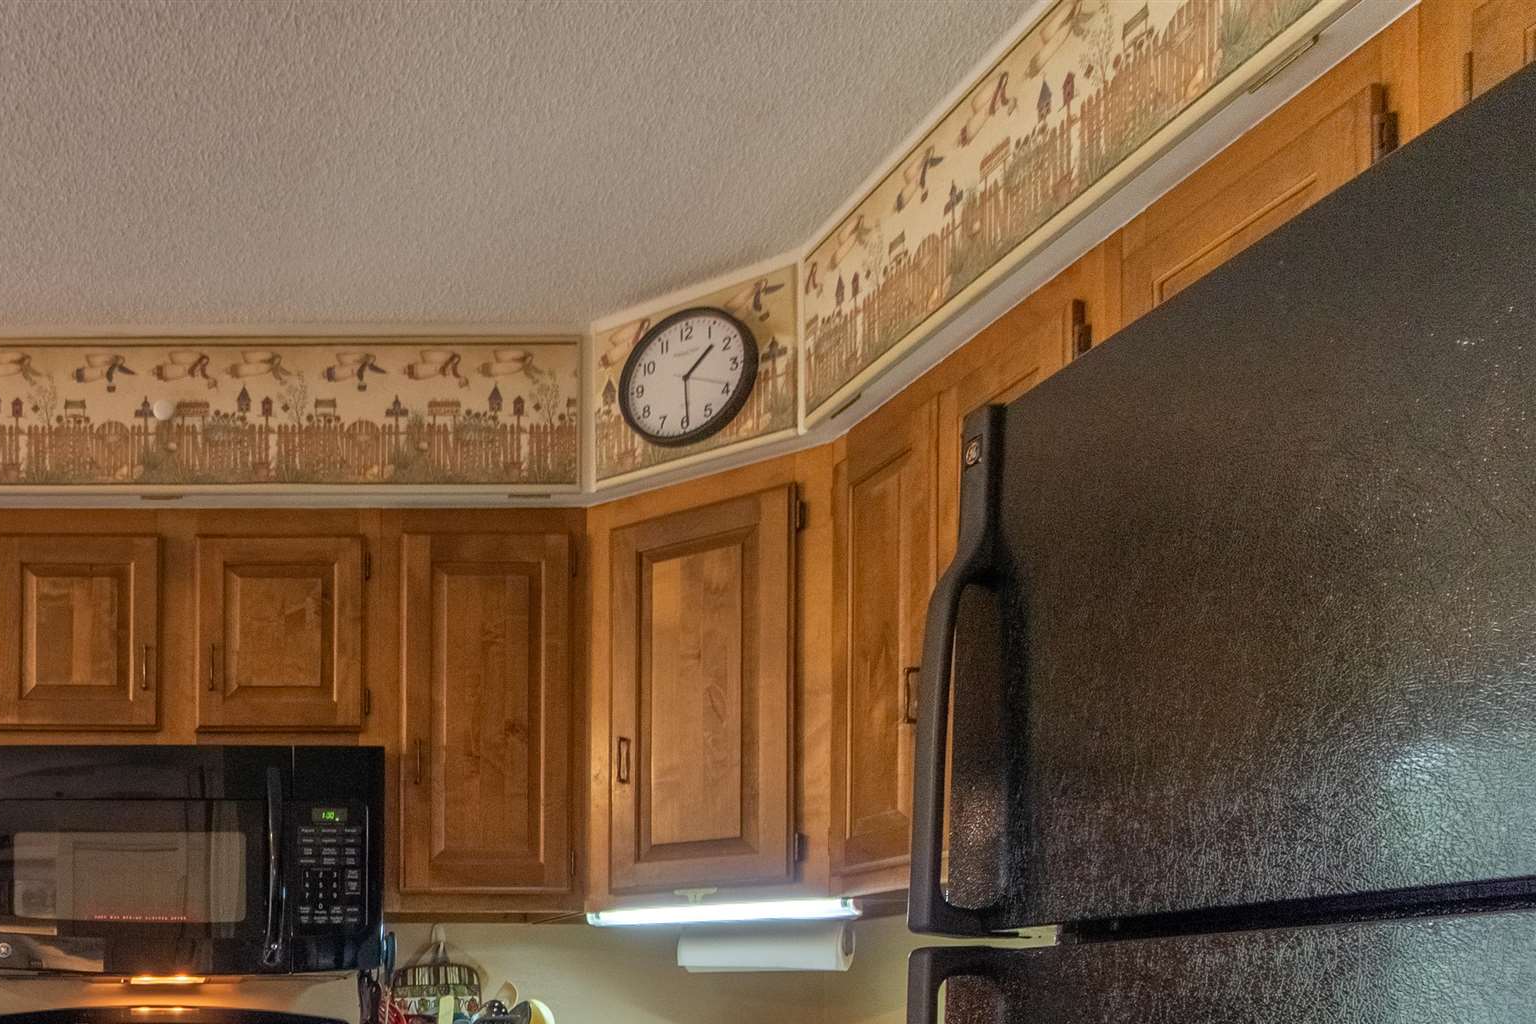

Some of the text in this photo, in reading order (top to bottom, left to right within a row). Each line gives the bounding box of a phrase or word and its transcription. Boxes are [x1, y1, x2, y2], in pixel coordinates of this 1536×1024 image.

[680, 327, 694, 342] 12
[708, 326, 712, 340] 1
[660, 340, 670, 355] 11
[721, 336, 732, 351] 2
[643, 362, 657, 376] 10
[729, 358, 739, 372] 3
[636, 385, 645, 399] 9
[721, 382, 731, 396] 4
[642, 405, 652, 419] 8
[704, 403, 713, 417] 5
[659, 416, 668, 430] 7
[680, 416, 690, 430] 6
